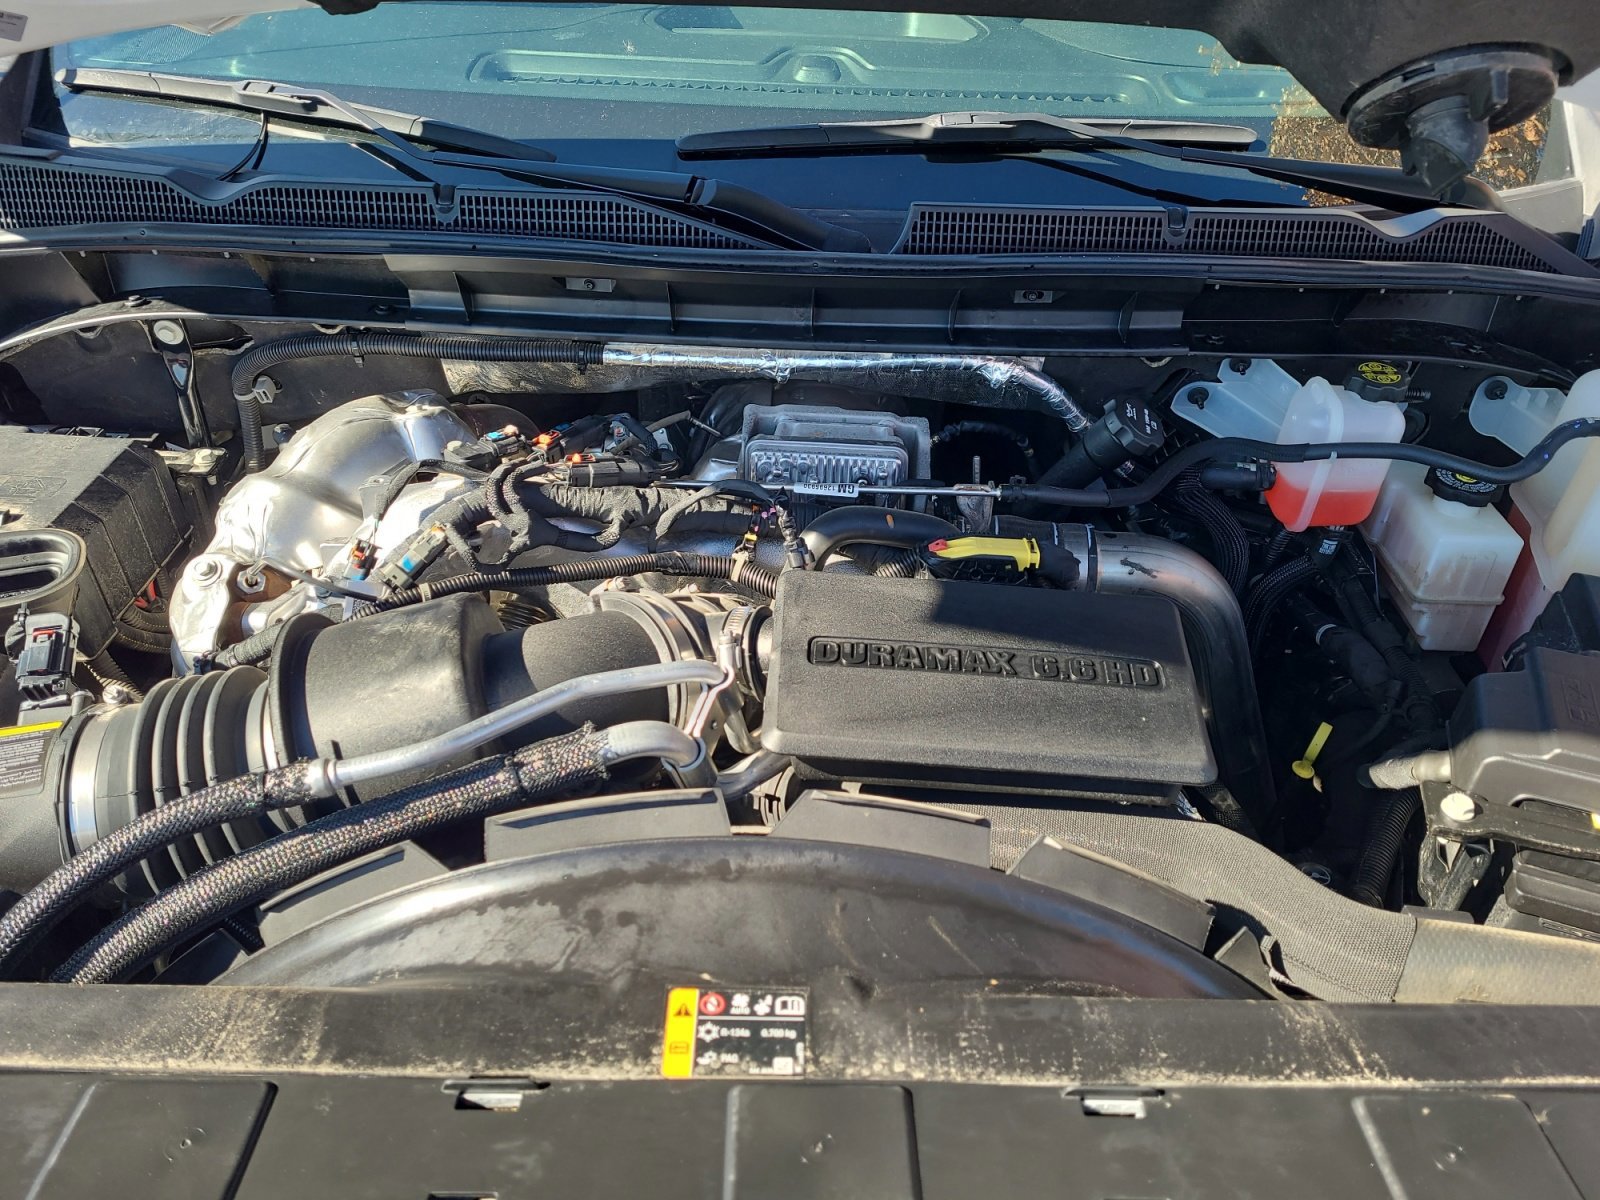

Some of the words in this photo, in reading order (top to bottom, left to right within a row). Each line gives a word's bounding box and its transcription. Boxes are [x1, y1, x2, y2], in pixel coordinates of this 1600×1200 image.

[838, 484, 855, 494] GM
[813, 640, 1018, 676] DURAMAX
[1031, 656, 1097, 682] 6.6
[1103, 660, 1160, 688] HD
